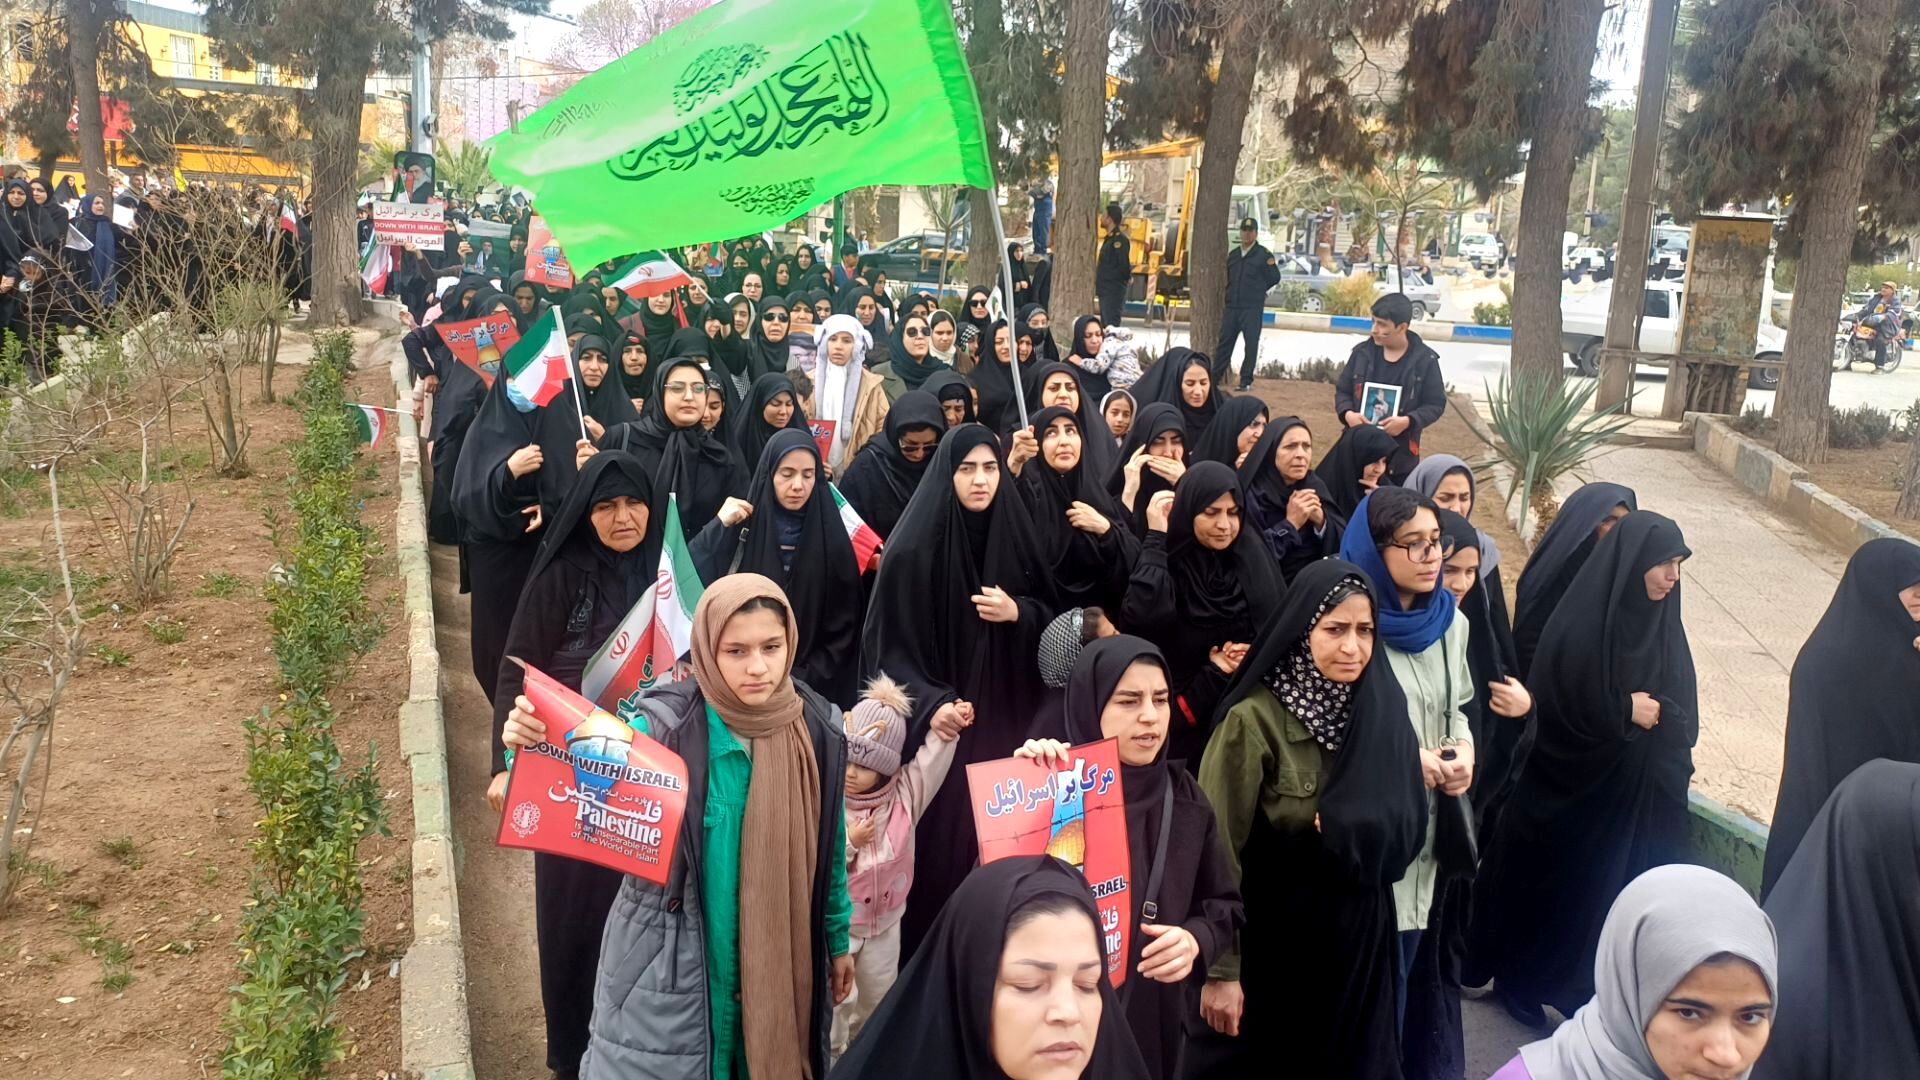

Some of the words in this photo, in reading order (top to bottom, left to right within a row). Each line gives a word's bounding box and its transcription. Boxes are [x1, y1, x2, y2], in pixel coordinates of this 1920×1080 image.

[398, 223, 416, 231] WITH
[417, 224, 443, 232] ISRAEL
[578, 757, 622, 778] WITH
[625, 769, 681, 790] ISRAEL
[1079, 766, 1114, 795] مرگ
[547, 779, 663, 824] فلسطین
[986, 775, 1057, 816] اسرائیل
[1061, 777, 1077, 805] بر
[574, 821, 583, 830] Is
[583, 825, 594, 834] an
[594, 826, 641, 850] Inseparable
[641, 844, 659, 856] Part
[575, 801, 661, 846] Palestine
[571, 830, 582, 839] of
[582, 831, 599, 845] The
[599, 838, 624, 853] World
[623, 846, 634, 857] of
[1090, 876, 1126, 899] SRAEL
